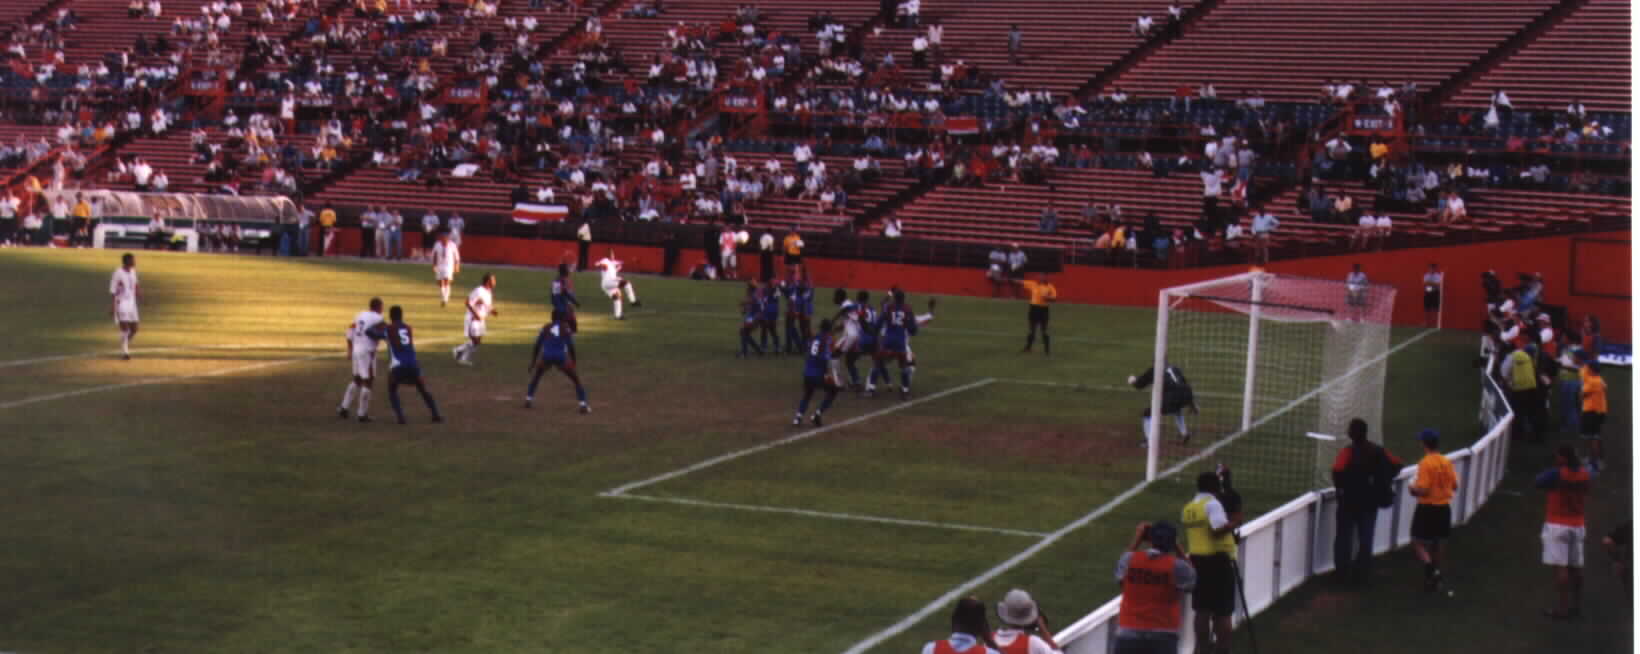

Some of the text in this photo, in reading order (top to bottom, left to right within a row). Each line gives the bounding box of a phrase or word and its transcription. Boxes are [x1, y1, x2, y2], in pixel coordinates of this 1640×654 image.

[891, 311, 905, 326] 12
[398, 328, 410, 346] 5
[549, 323, 560, 338] 4
[810, 338, 820, 356] 6
